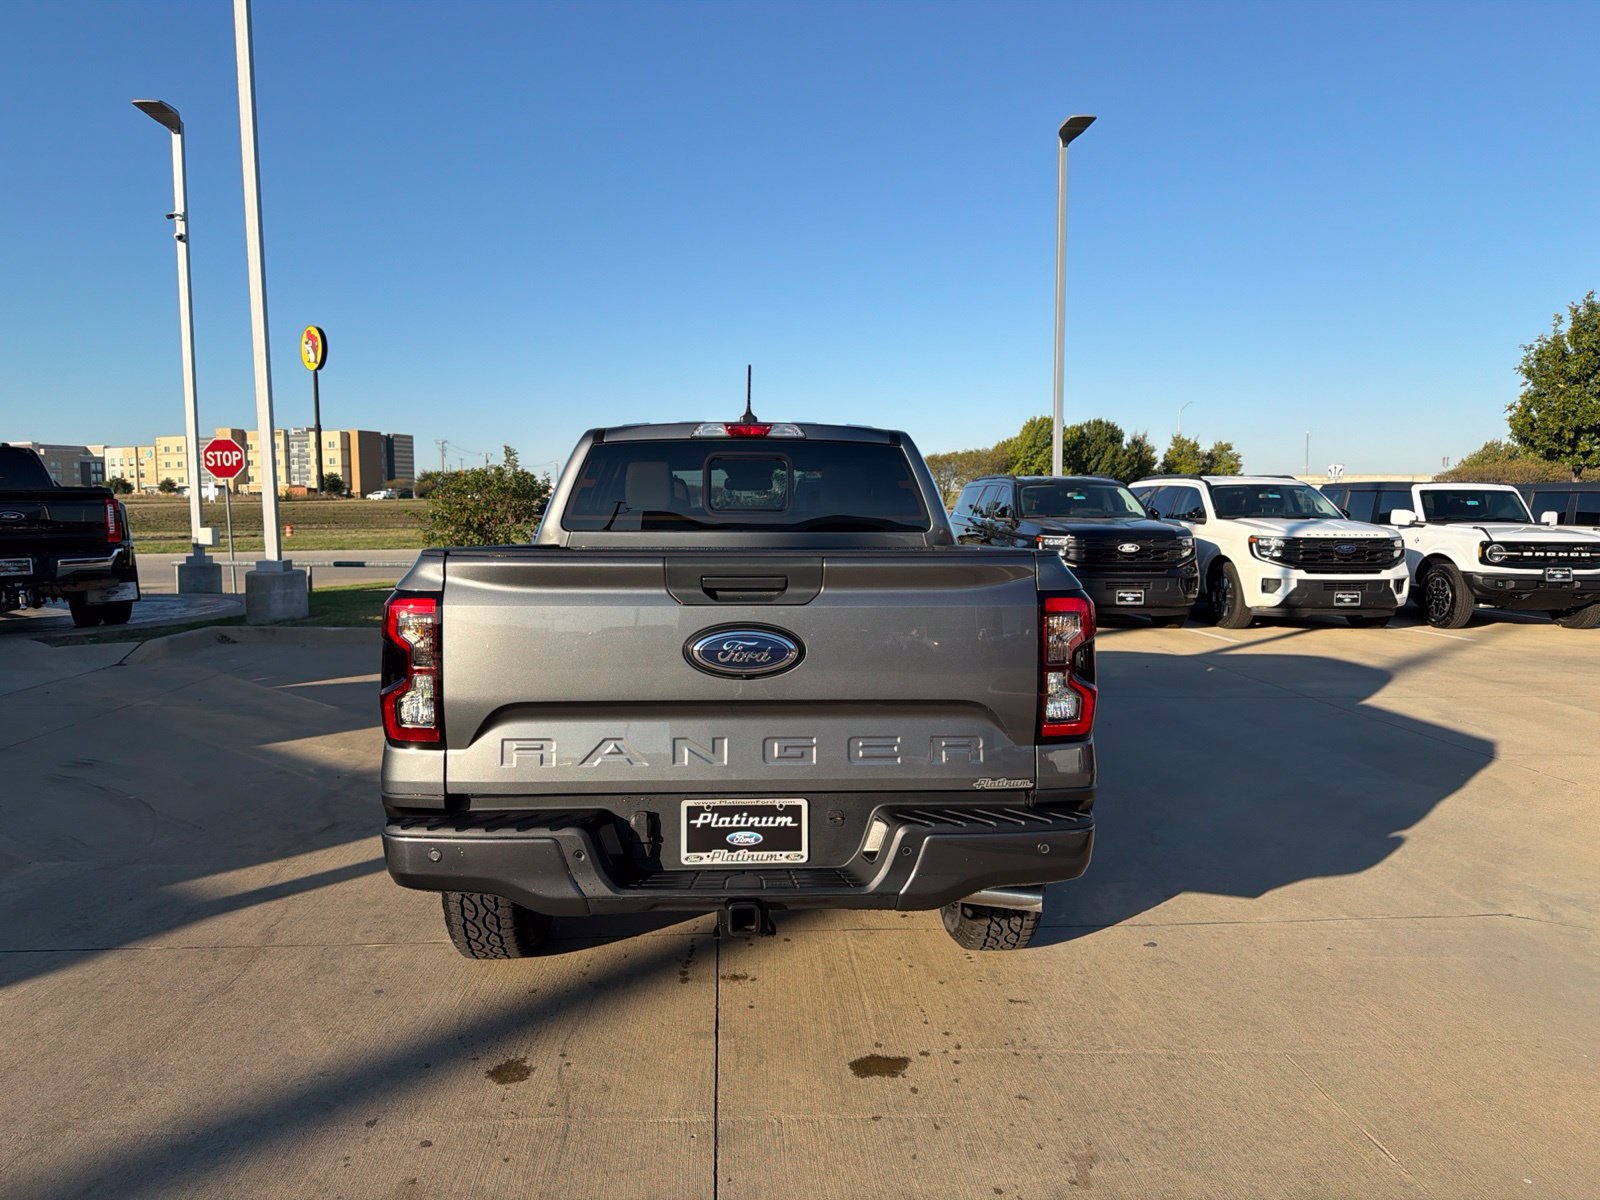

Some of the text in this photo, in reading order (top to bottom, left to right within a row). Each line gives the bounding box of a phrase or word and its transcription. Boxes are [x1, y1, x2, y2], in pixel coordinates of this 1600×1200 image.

[206, 451, 242, 467] STOP
[717, 640, 772, 662] Ford
[500, 737, 984, 767] RANGER
[972, 777, 1034, 790] Platinum
[689, 812, 799, 828] Platinum
[733, 832, 756, 843] Ford
[710, 850, 783, 862] Platinum
